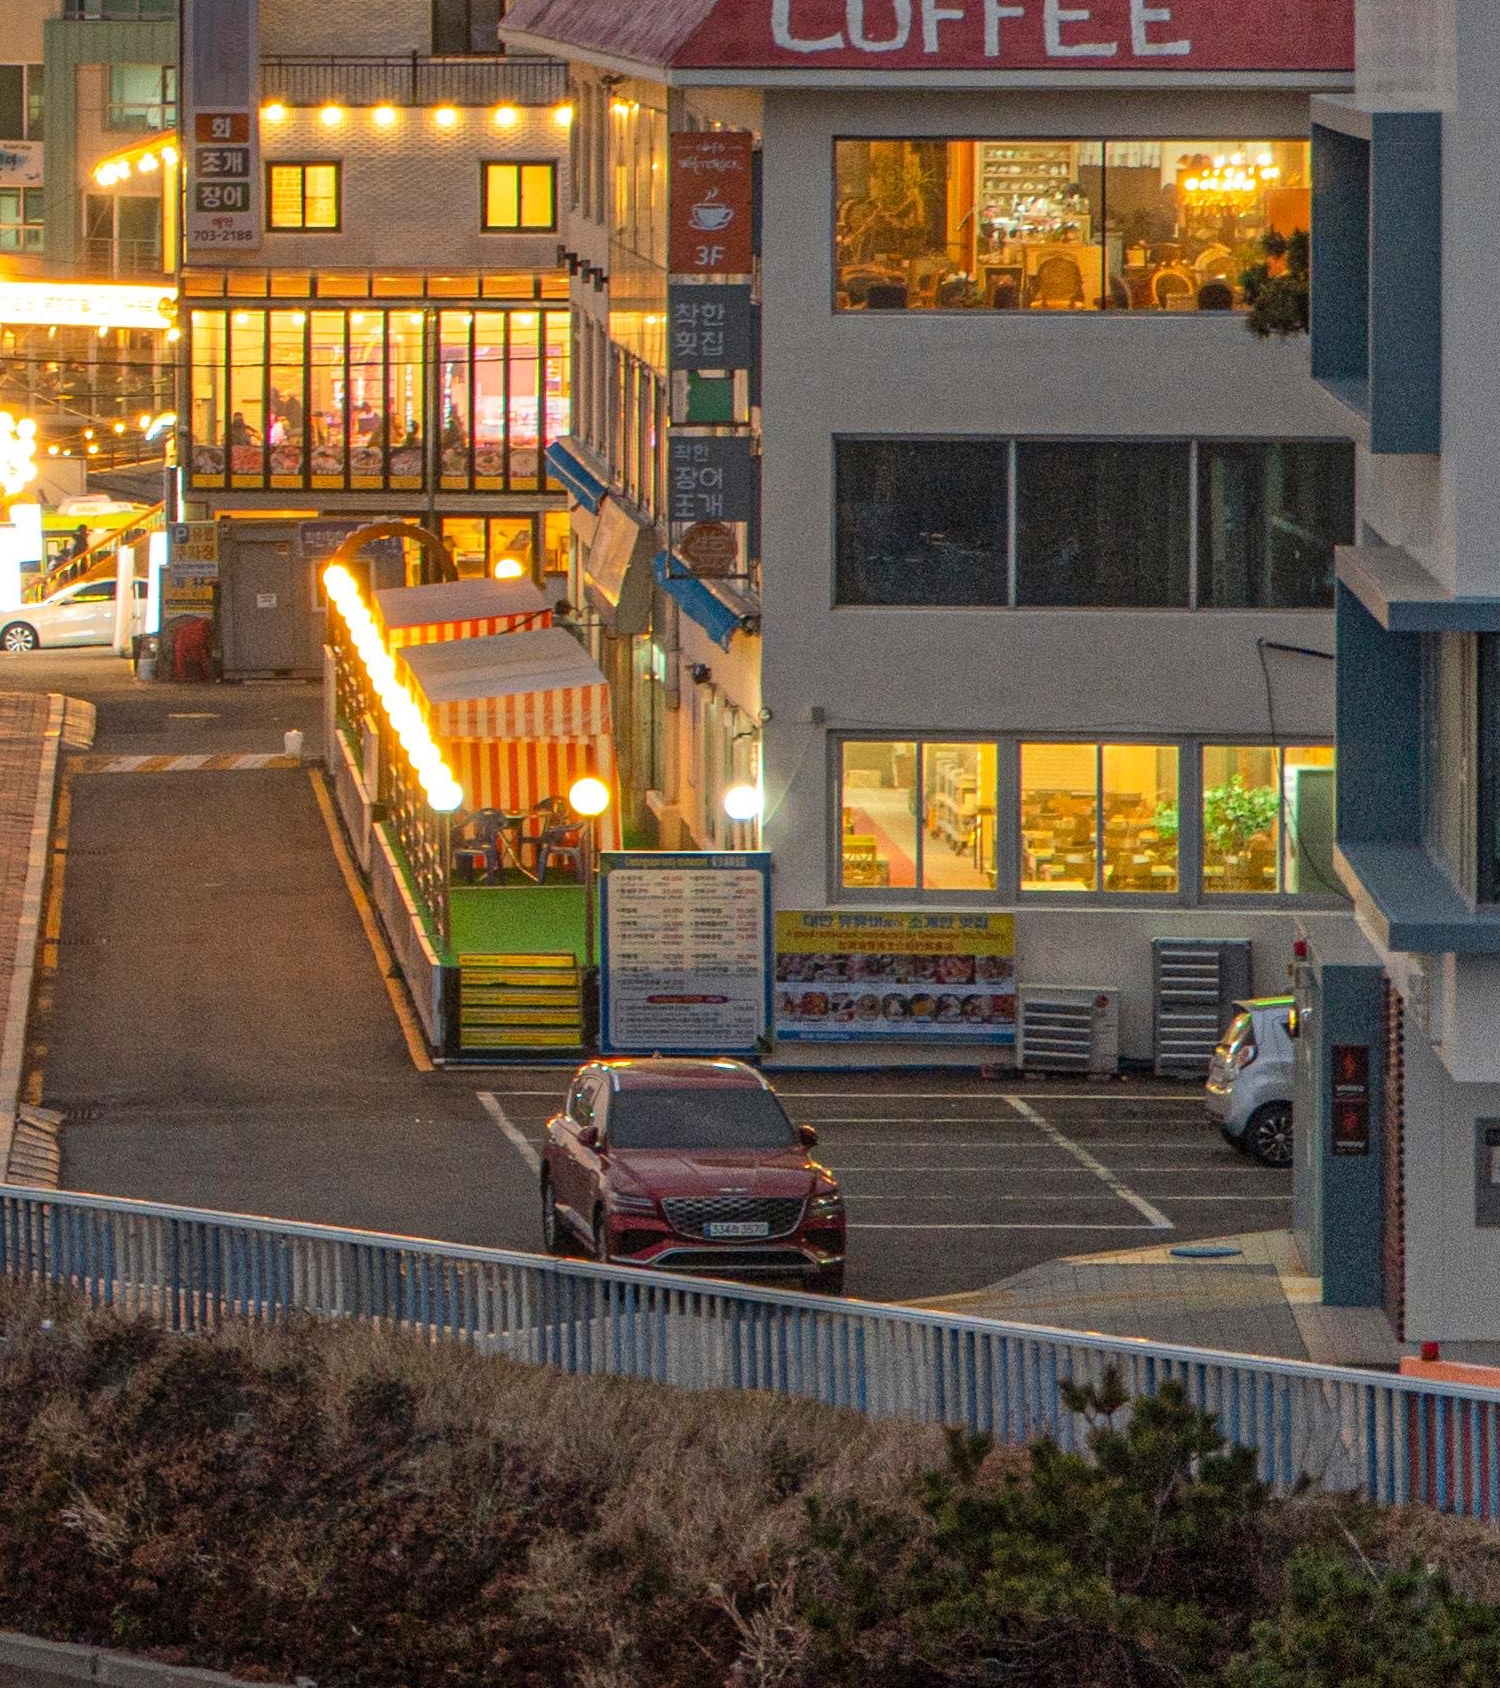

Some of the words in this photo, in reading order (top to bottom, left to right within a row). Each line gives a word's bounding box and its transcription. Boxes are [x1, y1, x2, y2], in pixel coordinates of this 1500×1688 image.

[211, 116, 231, 139] 회
[201, 151, 243, 174] 조개
[201, 185, 243, 208] 장어
[694, 246, 726, 266] 3F
[674, 302, 726, 328] 착한
[674, 331, 724, 356] 횟집
[674, 444, 710, 463] 착한
[674, 466, 723, 490] 장어
[674, 493, 723, 517] 조개
[175, 526, 187, 543] P
